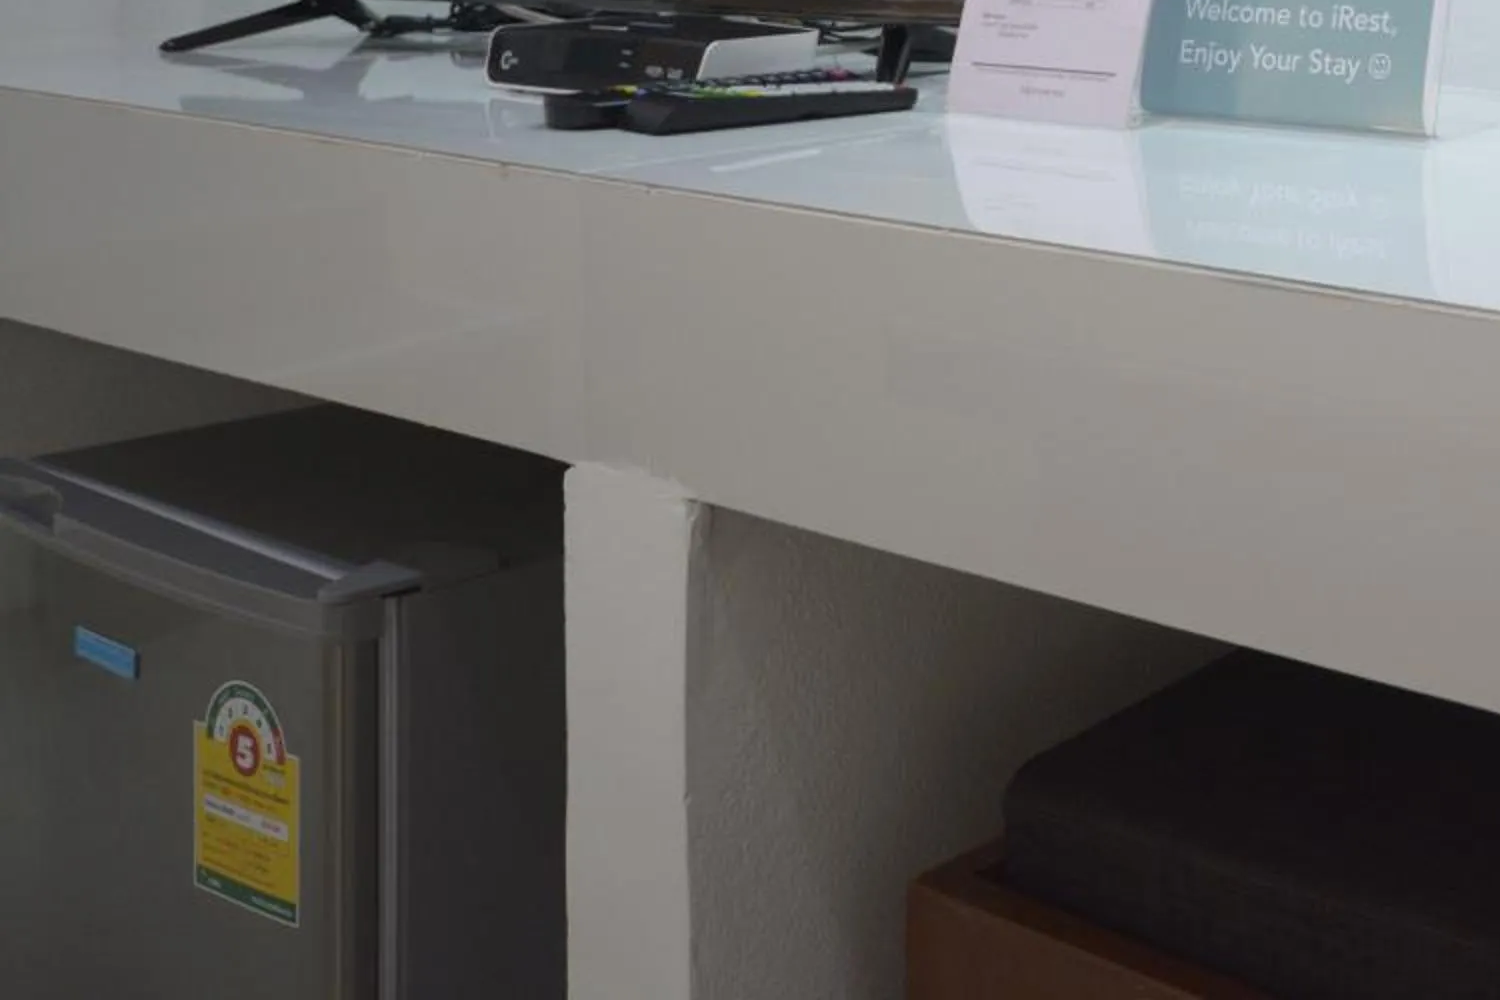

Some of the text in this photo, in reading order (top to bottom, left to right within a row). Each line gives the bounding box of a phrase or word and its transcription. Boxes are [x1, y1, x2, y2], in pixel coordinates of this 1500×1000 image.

[1299, 3, 1324, 29] to
[1179, 38, 1361, 85] Enjoy Your Stay
[235, 733, 256, 772] 5
